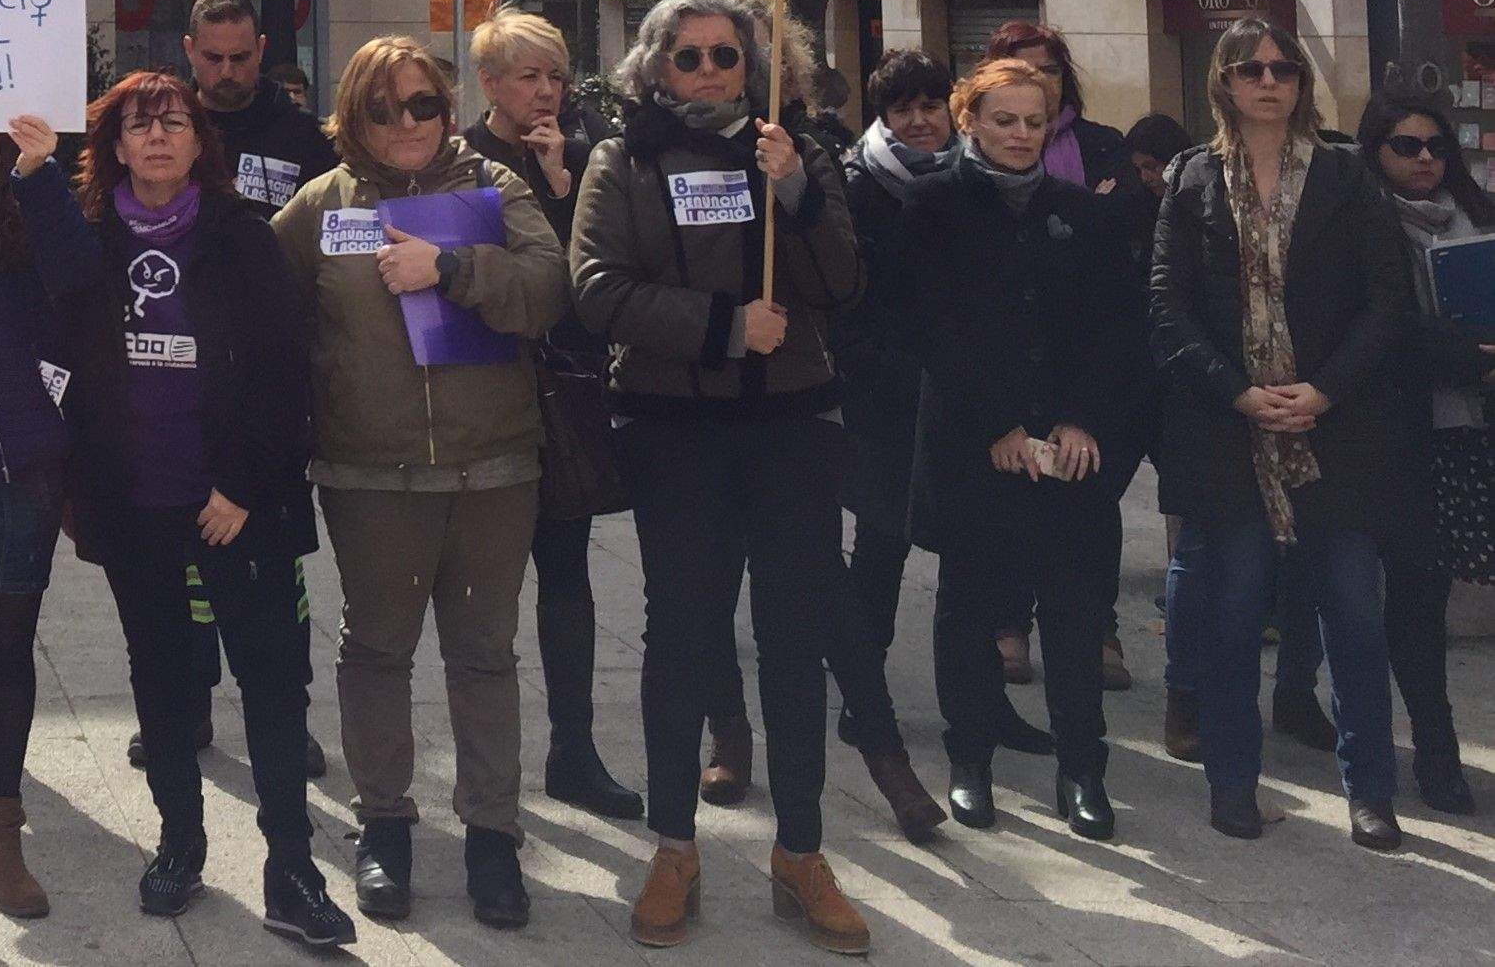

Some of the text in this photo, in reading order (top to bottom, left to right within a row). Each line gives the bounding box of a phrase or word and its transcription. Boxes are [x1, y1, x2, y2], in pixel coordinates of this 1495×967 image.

[242, 157, 253, 172] 8
[674, 177, 688, 194] 8
[327, 214, 339, 229] 8
